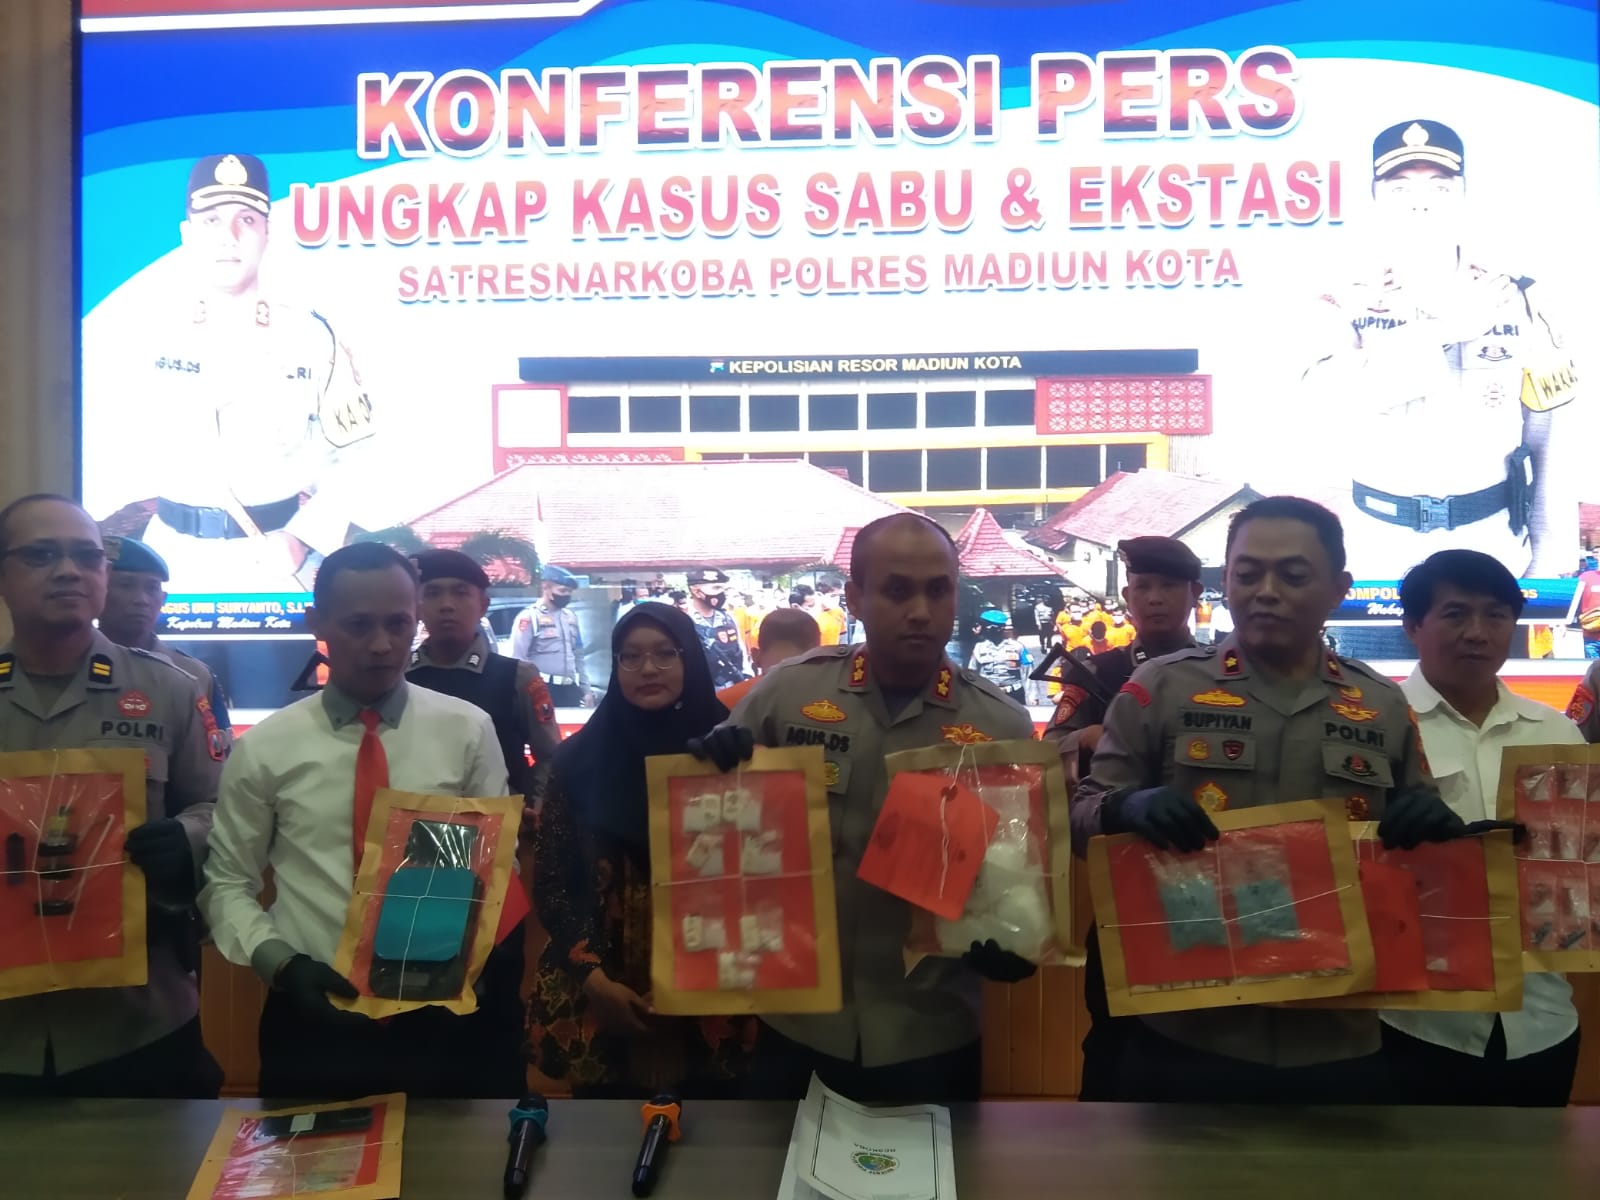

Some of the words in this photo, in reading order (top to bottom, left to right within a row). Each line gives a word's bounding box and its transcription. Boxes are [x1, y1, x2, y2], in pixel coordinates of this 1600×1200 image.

[359, 56, 997, 156] KONFERENSI
[1036, 48, 1299, 138] PERS
[294, 179, 548, 244] UNGKAP
[573, 173, 782, 236] KASUS
[804, 169, 974, 231] SABU
[1000, 167, 1042, 228] &
[1068, 160, 1342, 225] EKSTASI
[398, 257, 748, 298] SATRESNARKOBA
[769, 254, 928, 292] POLRES
[944, 250, 1108, 288] MADIUN
[1125, 247, 1240, 284] KOTA
[729, 359, 833, 374] KEPOLISIAN
[837, 358, 898, 373] RESOR
[901, 357, 969, 371] MADIUN
[973, 355, 1022, 370] KOTA
[101, 720, 164, 741] POLRI
[1182, 711, 1252, 731] SUPIYAN
[1325, 721, 1385, 748] POLRI
